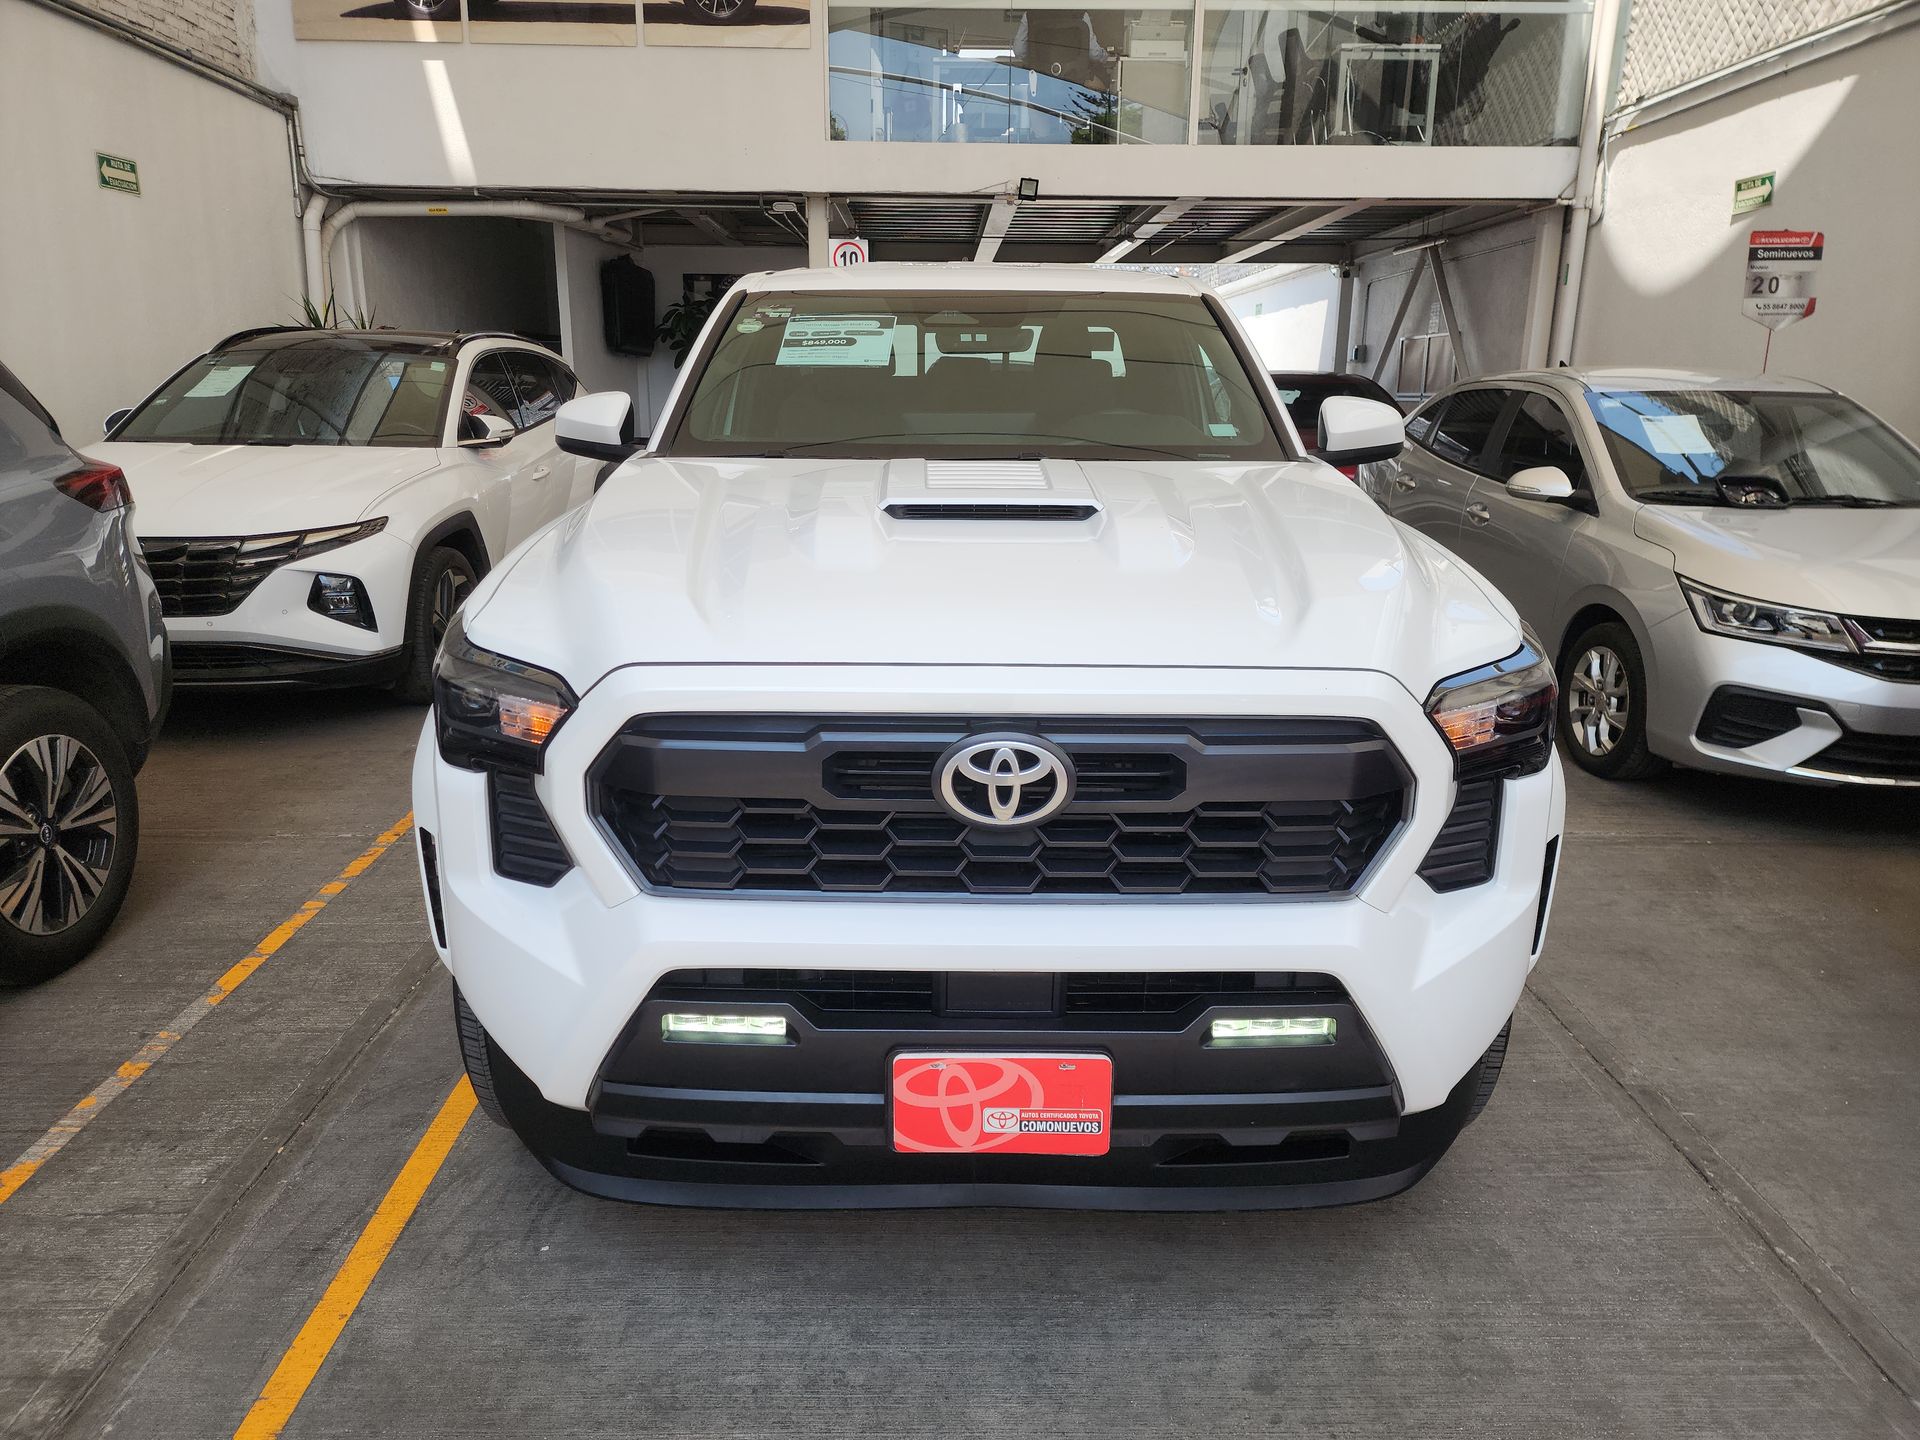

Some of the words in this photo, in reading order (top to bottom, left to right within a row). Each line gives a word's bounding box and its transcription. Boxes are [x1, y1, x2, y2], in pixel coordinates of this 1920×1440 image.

[840, 250, 858, 267] 10
[1757, 248, 1814, 259] Seminuevos
[801, 339, 847, 347] $849,000
[1021, 1121, 1099, 1132] COMONUEVOS
